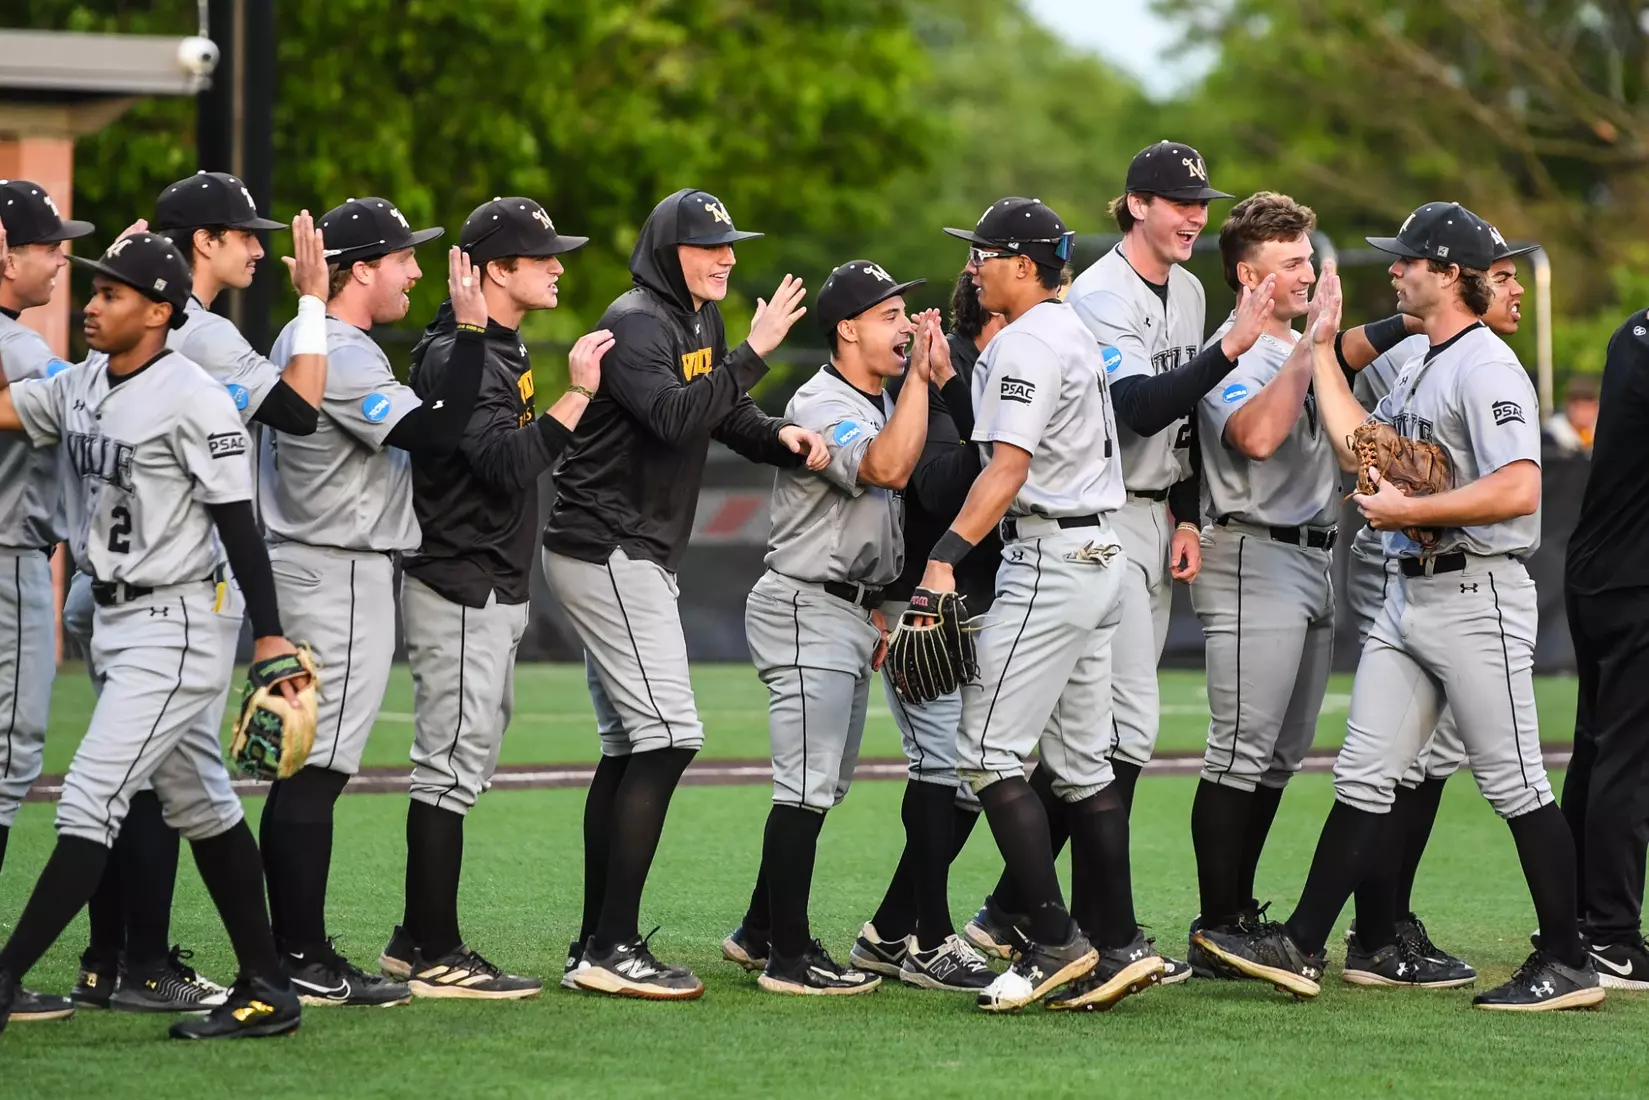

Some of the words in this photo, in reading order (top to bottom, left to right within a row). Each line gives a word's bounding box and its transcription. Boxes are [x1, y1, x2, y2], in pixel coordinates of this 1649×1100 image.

[1000, 382, 1035, 399] PSAC
[209, 436, 245, 452] PSAC
[107, 505, 132, 554] 2
